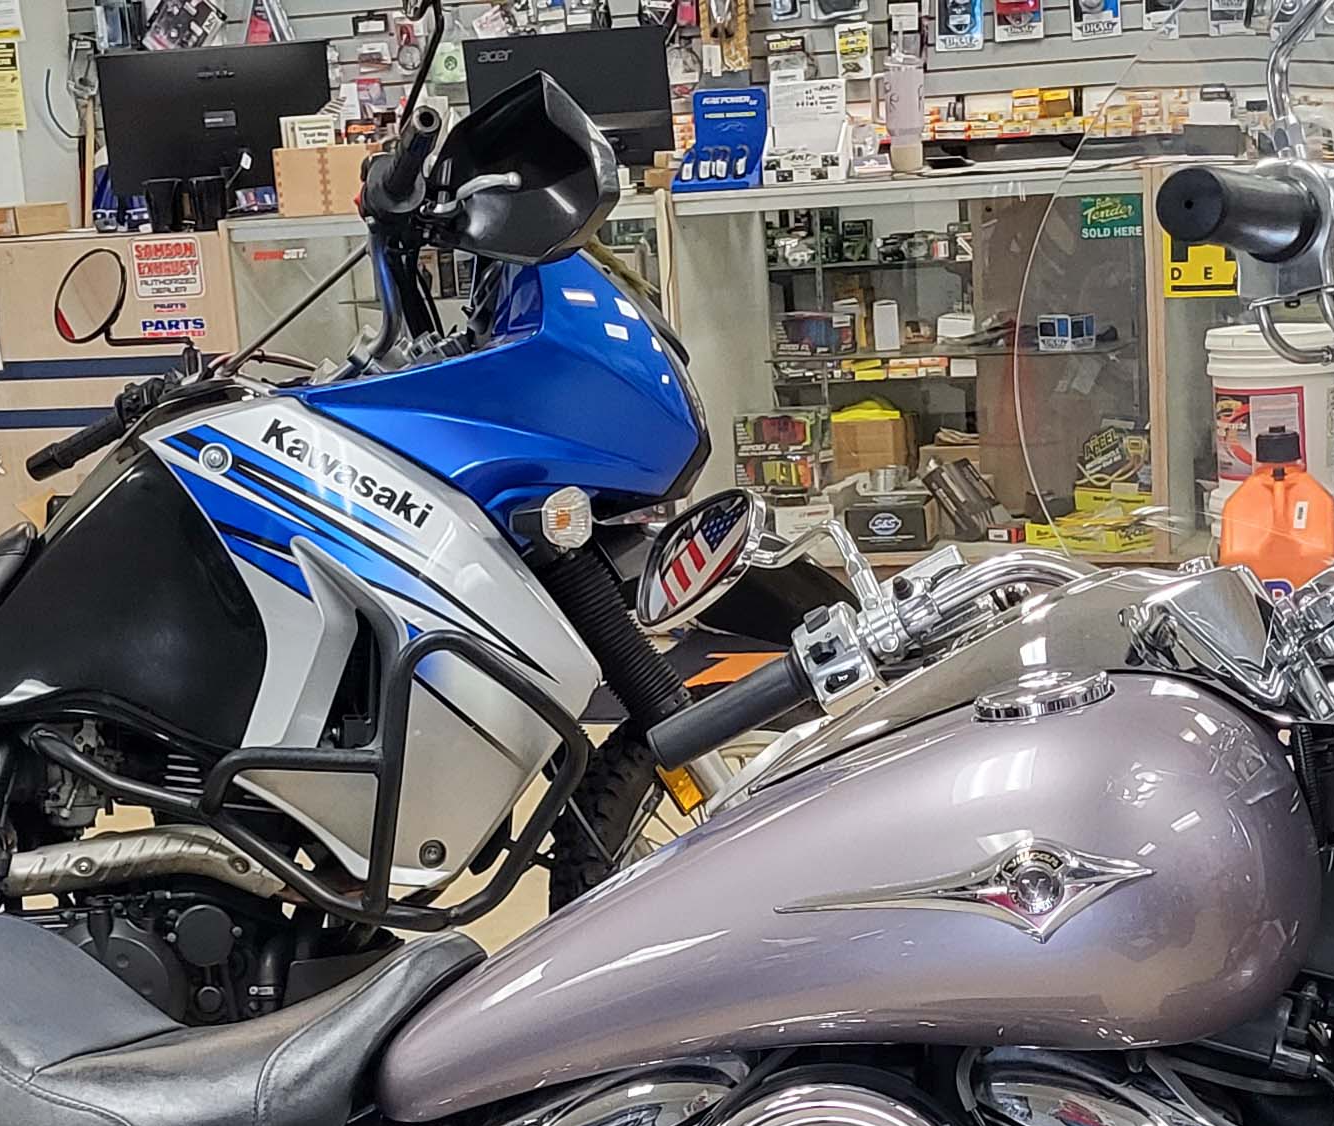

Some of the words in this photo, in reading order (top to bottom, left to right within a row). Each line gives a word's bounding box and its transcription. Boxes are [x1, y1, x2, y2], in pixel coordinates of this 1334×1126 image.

[478, 49, 512, 62] acer
[1083, 206, 1135, 225] Tender
[1082, 227, 1110, 239] SOLD
[1114, 226, 1143, 237] HERE
[135, 242, 196, 260] SAMSON
[137, 261, 198, 277] EXHAUST
[140, 277, 197, 287] AUTHORIZED
[151, 286, 187, 295] DEALER
[142, 318, 204, 331] PARTS
[259, 418, 434, 530] Kawasaki
[873, 517, 899, 531] S&S
